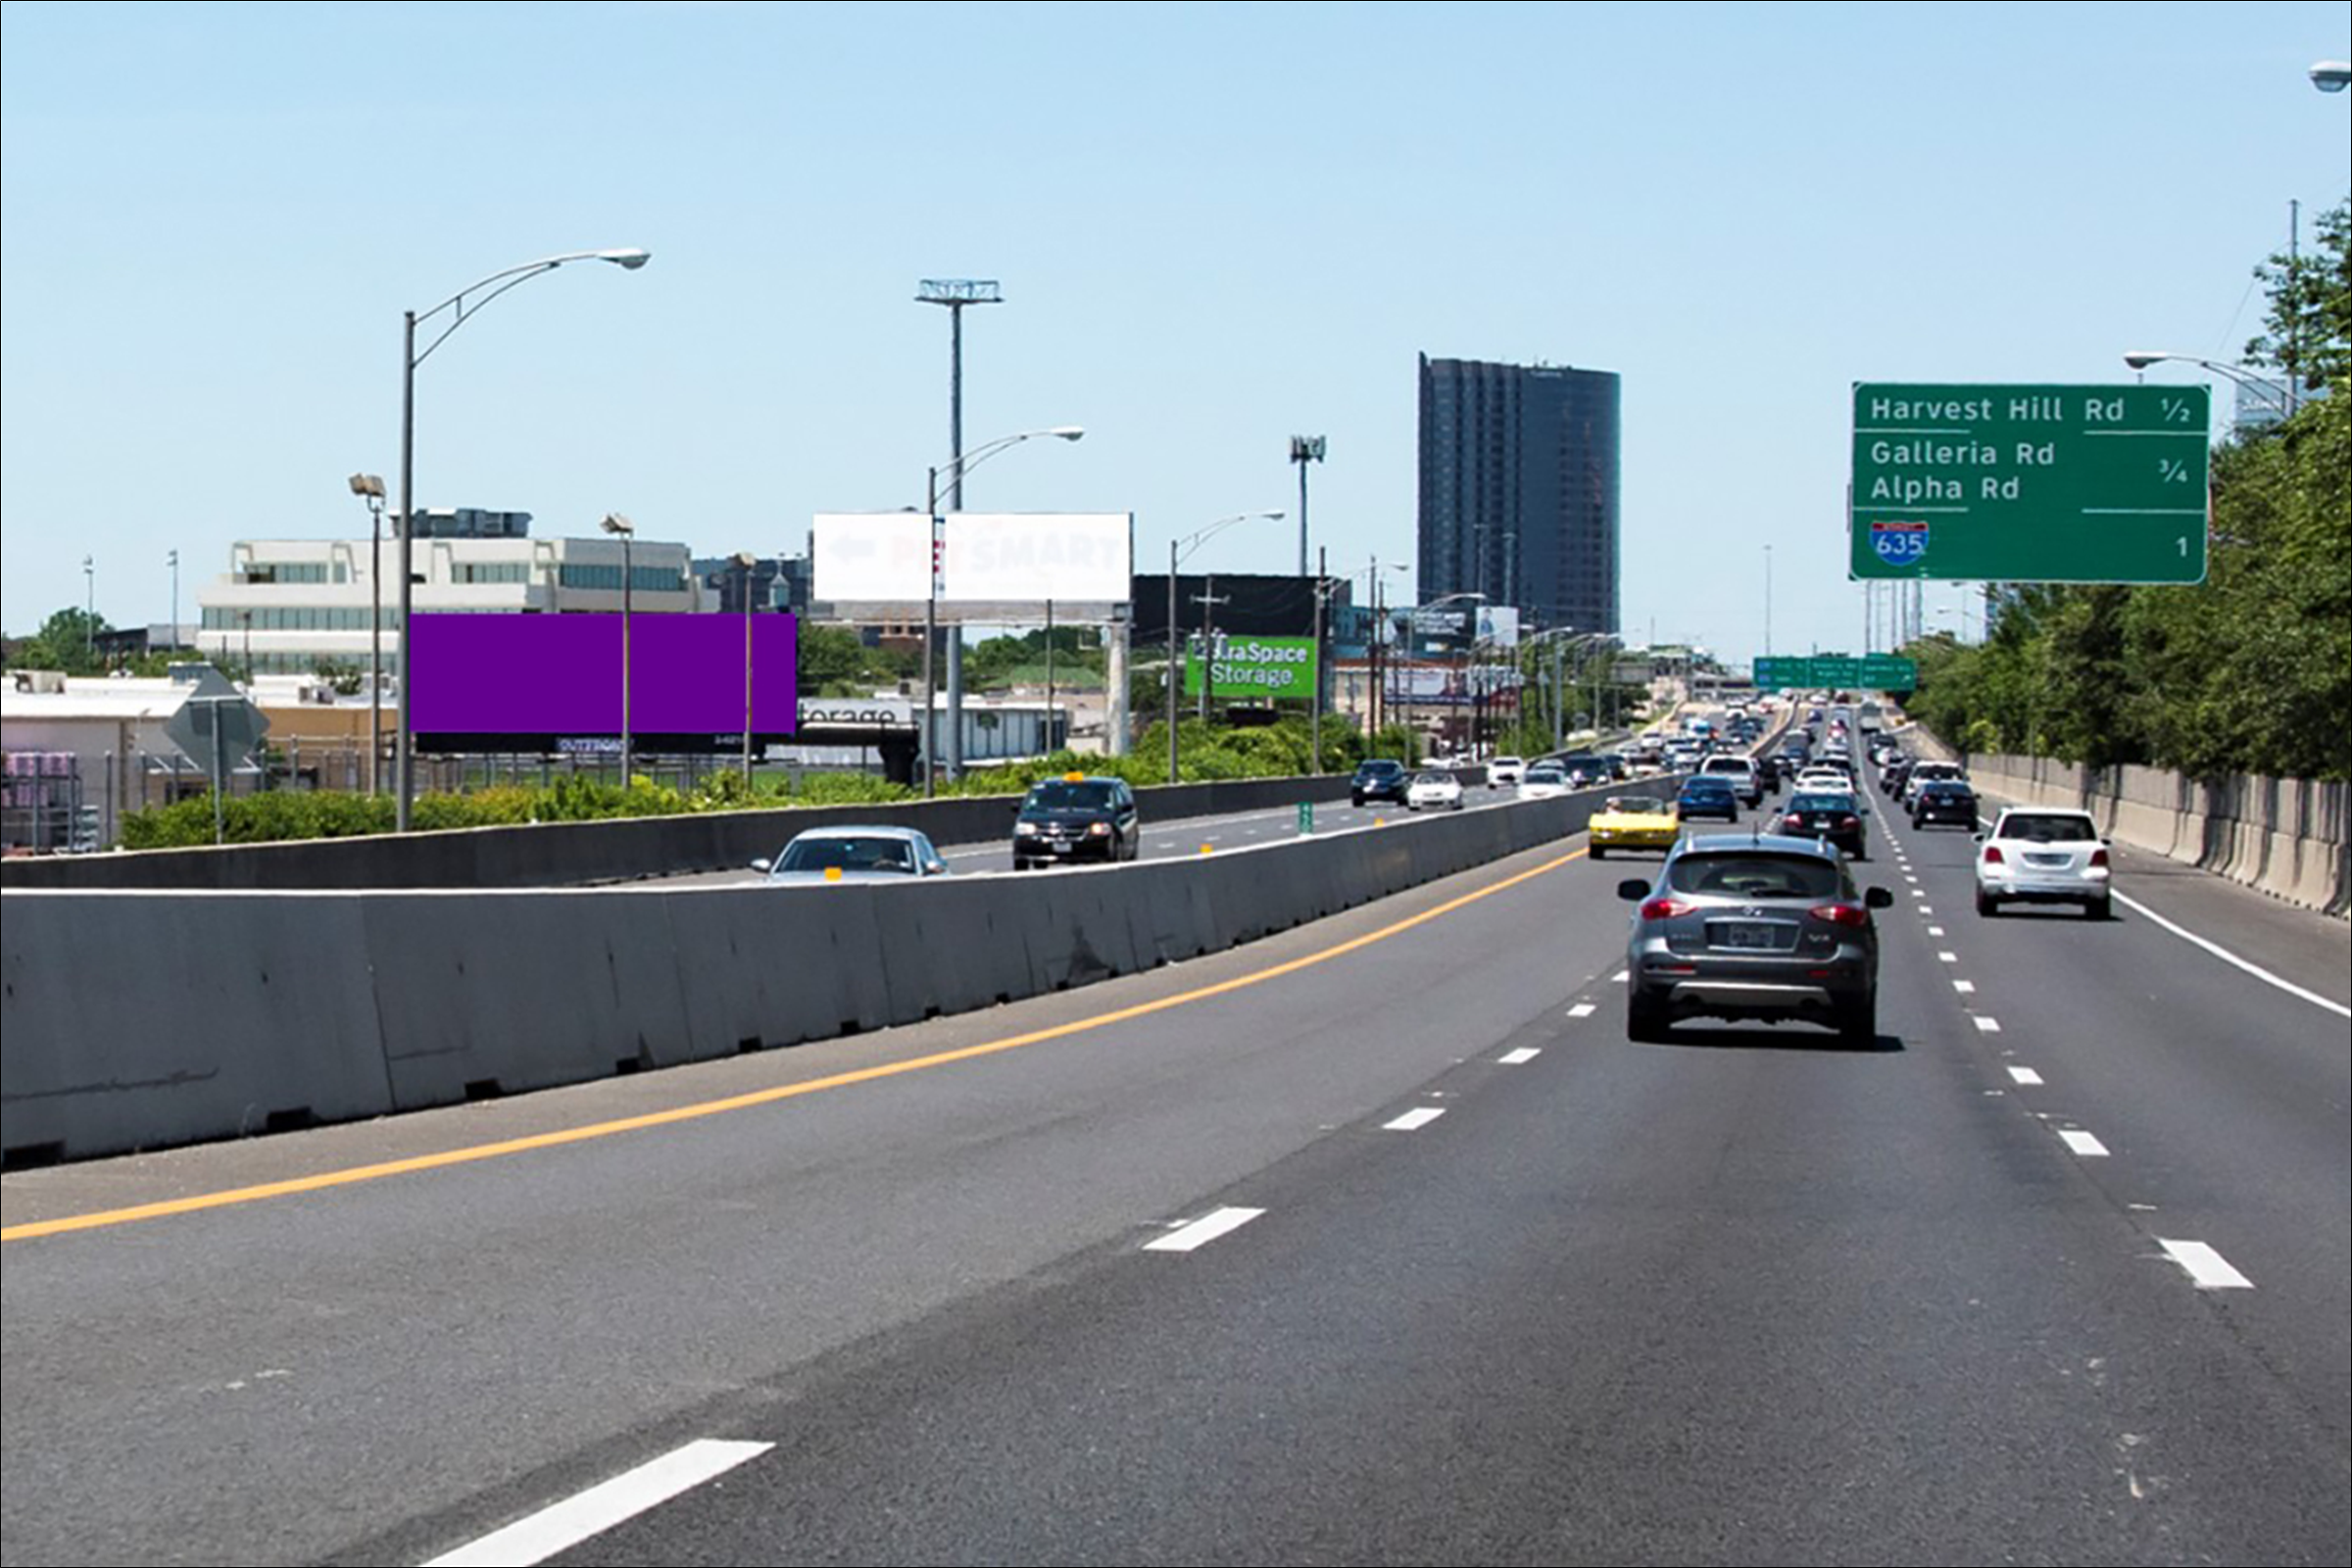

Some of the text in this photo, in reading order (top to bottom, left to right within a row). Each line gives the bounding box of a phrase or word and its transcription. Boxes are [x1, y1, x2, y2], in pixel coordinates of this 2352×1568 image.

[1872, 397, 2124, 421] Harvest Hill Rd
[1871, 441, 2055, 466] Galleria Rd
[1871, 476, 2020, 505] Alpha Rd
[1876, 533, 1927, 556] 635
[2176, 537, 2188, 557] 1
[798, 701, 896, 723] torage
